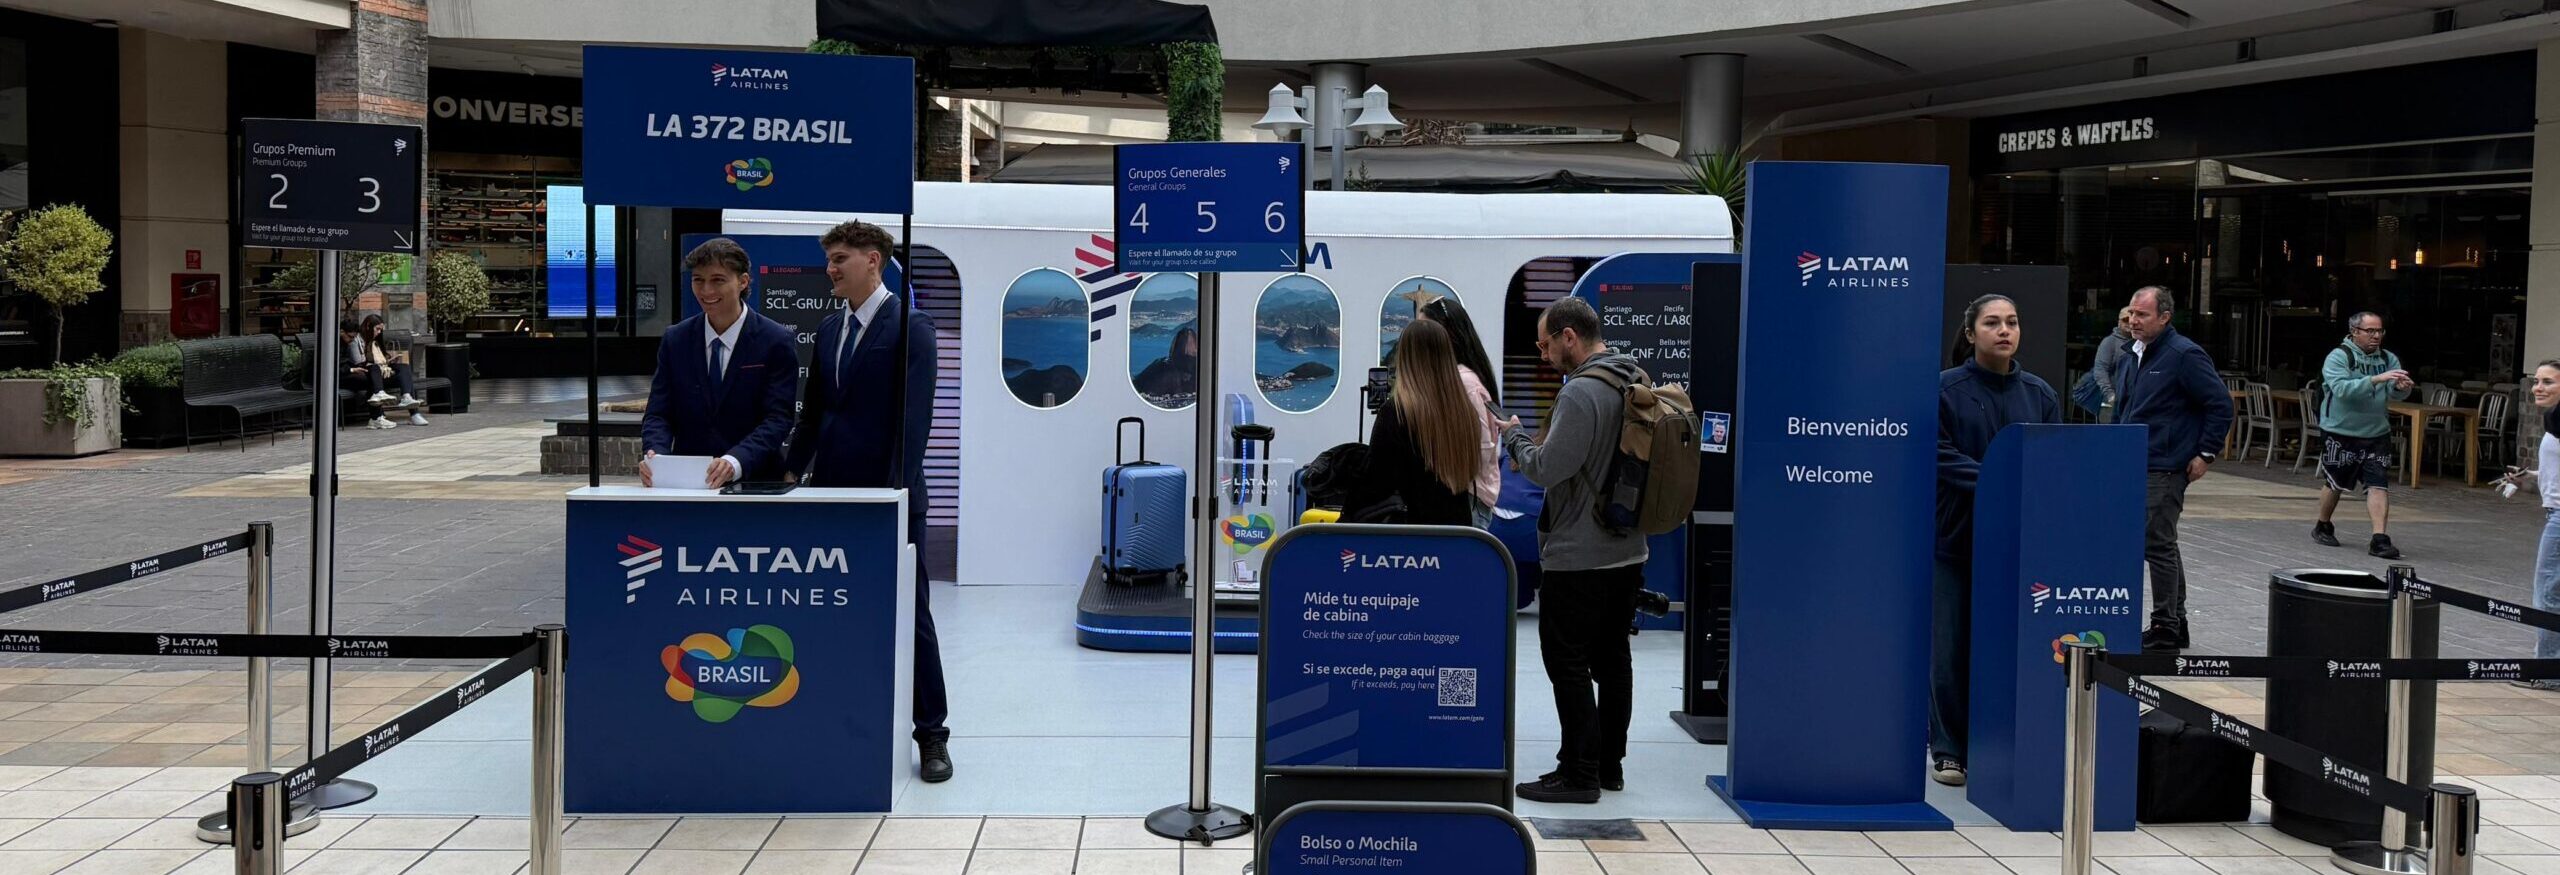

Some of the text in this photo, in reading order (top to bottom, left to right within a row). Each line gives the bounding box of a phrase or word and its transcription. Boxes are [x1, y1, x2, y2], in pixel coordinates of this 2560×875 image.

[731, 67, 788, 80] LATAM
[731, 81, 789, 90] AIRLINES
[433, 96, 583, 127] ONVERSE
[647, 113, 852, 144] LA 372 BRASIL
[1999, 117, 2154, 153] CREPES & WAFFLES
[253, 143, 336, 157] Grupos Premium
[252, 158, 307, 168] Premium Groups
[736, 168, 764, 178] BRASIL
[1128, 166, 1227, 183] Grupos Generales
[269, 174, 381, 213] 2 3
[1128, 182, 1186, 192] General Groups
[1129, 201, 1286, 234] 4 5 6
[251, 223, 271, 232] Espere
[280, 224, 305, 233] llamado
[307, 226, 315, 234] de
[328, 228, 349, 237] grupo
[1128, 249, 1152, 258] Espere
[1162, 249, 1191, 257] llamado
[1215, 250, 1237, 259] grupo
[1828, 256, 1909, 271] LATAM
[1828, 277, 1909, 288] AIRLINES
[766, 288, 797, 297] Santiago
[766, 298, 789, 309] SCL
[826, 298, 831, 310] /
[834, 298, 848, 309] LA
[1604, 305, 1632, 314] Santiago
[1603, 315, 1625, 326] SCL
[1656, 314, 1662, 326] /
[1664, 315, 1691, 326] LA80
[1604, 339, 1631, 347] Santiago
[1631, 348, 1654, 359] CNF
[1787, 417, 1908, 437] Bienvenidos
[1786, 465, 1873, 483] Welcome
[1234, 478, 1278, 487] LATAM
[1235, 529, 1266, 539] BRASIL
[208, 540, 227, 551] LATAM
[137, 558, 159, 570] LATAM
[677, 546, 849, 574] LATAM
[1361, 555, 1440, 570] LATAM
[50, 579, 76, 592] LATAM
[2409, 581, 2431, 593] LATAM
[677, 587, 849, 606] AIRLINES
[2055, 587, 2130, 600] LATAM
[1303, 592, 1420, 610] Mide tu equipaje
[1303, 607, 1369, 622] de cabina
[2055, 605, 2130, 615] AIRLINES
[2495, 603, 2521, 616] LATAM
[0, 634, 40, 643] ATAM
[172, 637, 218, 647] LATAM
[1302, 629, 1460, 644] Check the size of your cabin baggage
[343, 640, 389, 649] LATAM
[2188, 659, 2230, 669] LATAM
[2340, 662, 2381, 671] LATAM
[2481, 663, 2521, 671] LATAM
[698, 665, 771, 684] BRASIL
[1303, 663, 1436, 679] Si se excede, paga aquí
[464, 678, 485, 696] LATAM
[1401, 682, 1416, 691] pay
[1418, 681, 1435, 689] here
[2135, 681, 2160, 700] LATAM
[374, 723, 399, 744] LATAM
[2220, 717, 2249, 737] LATAM
[374, 735, 399, 754] AIRLINES
[2220, 729, 2249, 747] AIRLINES
[285, 767, 316, 788] ATAM
[2333, 764, 2370, 786] LATAM
[289, 780, 316, 800] IRLINES
[2333, 777, 2370, 796] AIRLINES
[1300, 835, 1418, 851] Bolso o Mochila
[1300, 854, 1403, 867] Small Personal Item
